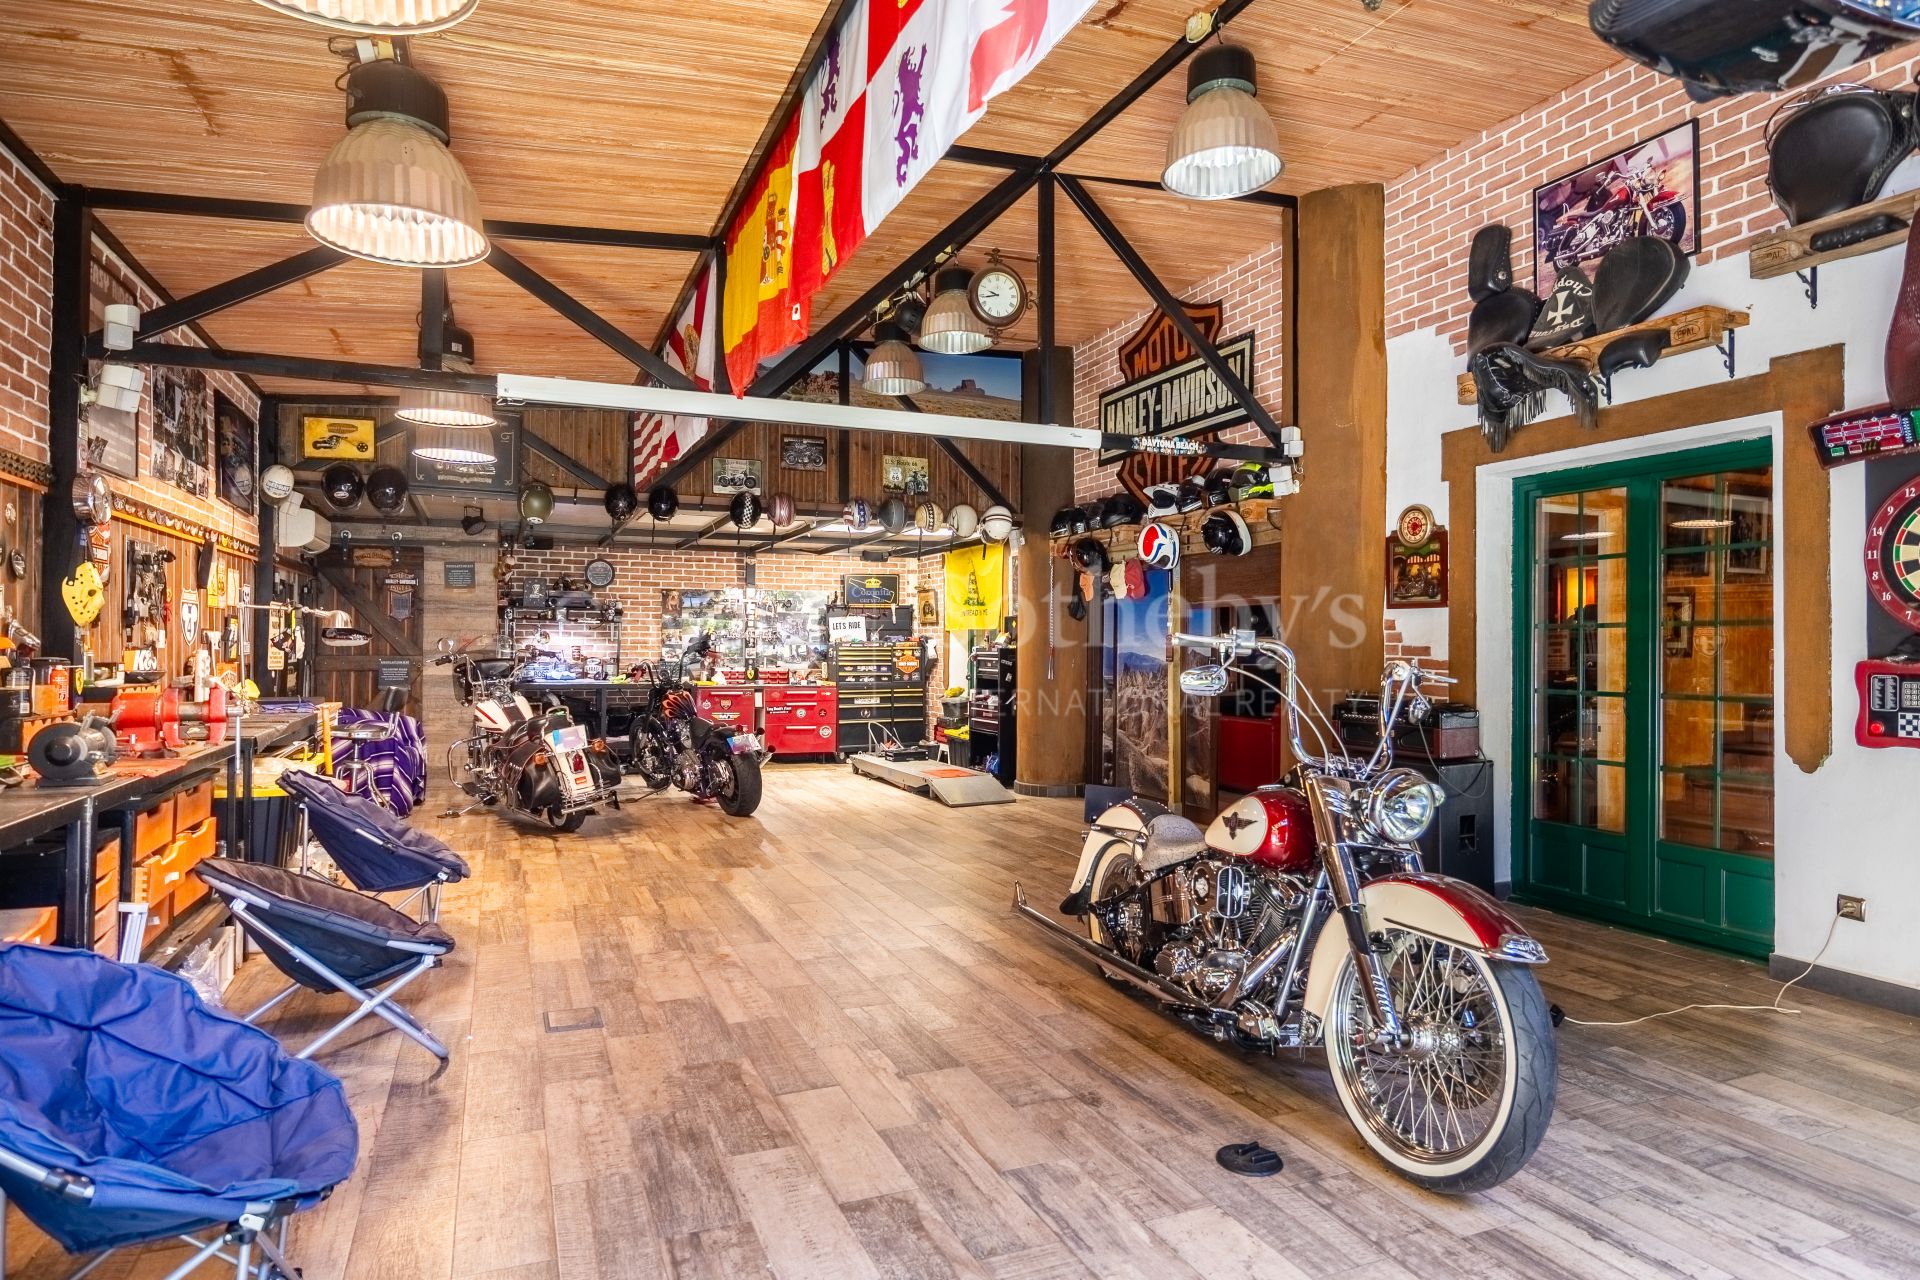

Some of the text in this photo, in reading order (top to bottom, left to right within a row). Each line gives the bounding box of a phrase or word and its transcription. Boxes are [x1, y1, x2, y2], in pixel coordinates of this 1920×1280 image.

[1677, 328, 1697, 339] EPAL
[1106, 354, 1242, 436] HARLEY-DAVIDSON
[1141, 436, 1175, 449] DAYTONA
[1175, 440, 1199, 451] BEACH
[1904, 487, 1916, 498] 12
[1887, 505, 1894, 515] 9
[1871, 527, 1883, 537] 14
[1866, 550, 1878, 559] 11
[1872, 571, 1879, 580] 8
[1881, 591, 1892, 601] 16
[1905, 610, 1912, 620] 7
[848, 621, 862, 630] RIDE
